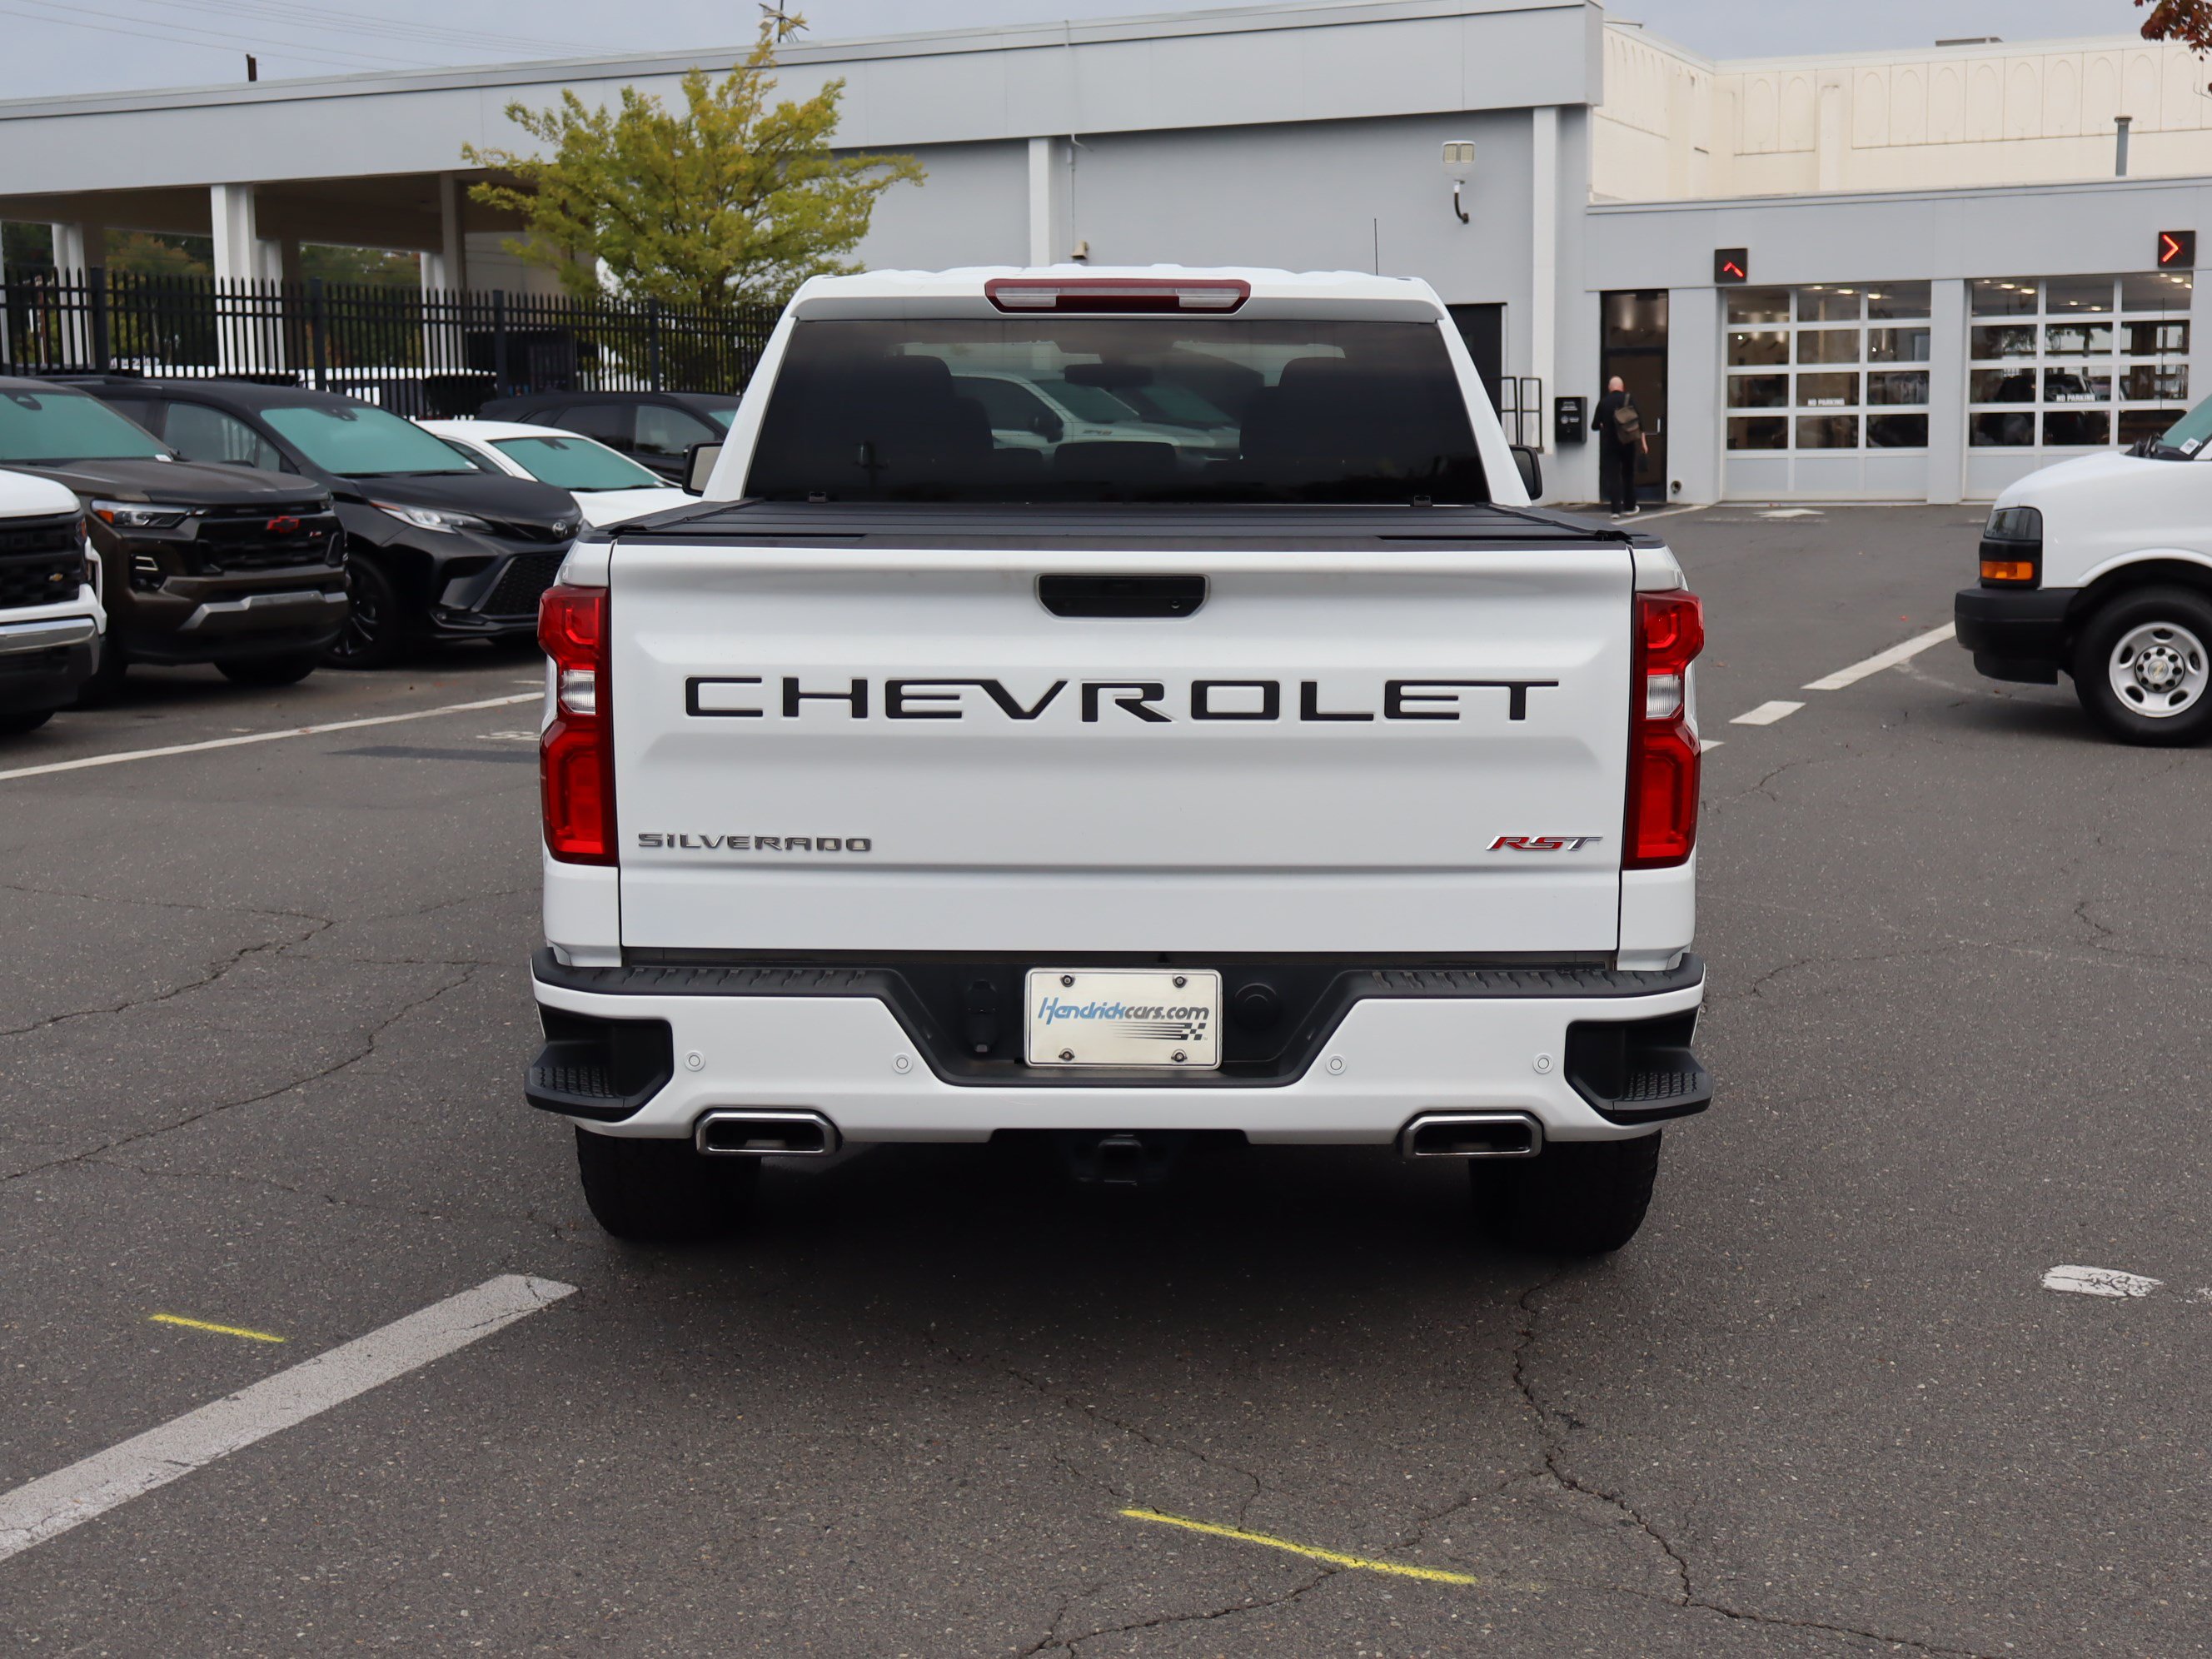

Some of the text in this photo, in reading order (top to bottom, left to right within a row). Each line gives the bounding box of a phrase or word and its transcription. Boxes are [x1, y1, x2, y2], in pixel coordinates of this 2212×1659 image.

[1807, 398, 1845, 406] NO PARKING
[2056, 393, 2095, 402] NO PARKING
[685, 676, 1559, 723] CHEVROLET
[638, 833, 872, 851] SILVERADO
[1486, 835, 1603, 851] RST
[1038, 997, 1209, 1025] Hendrickcars.com
